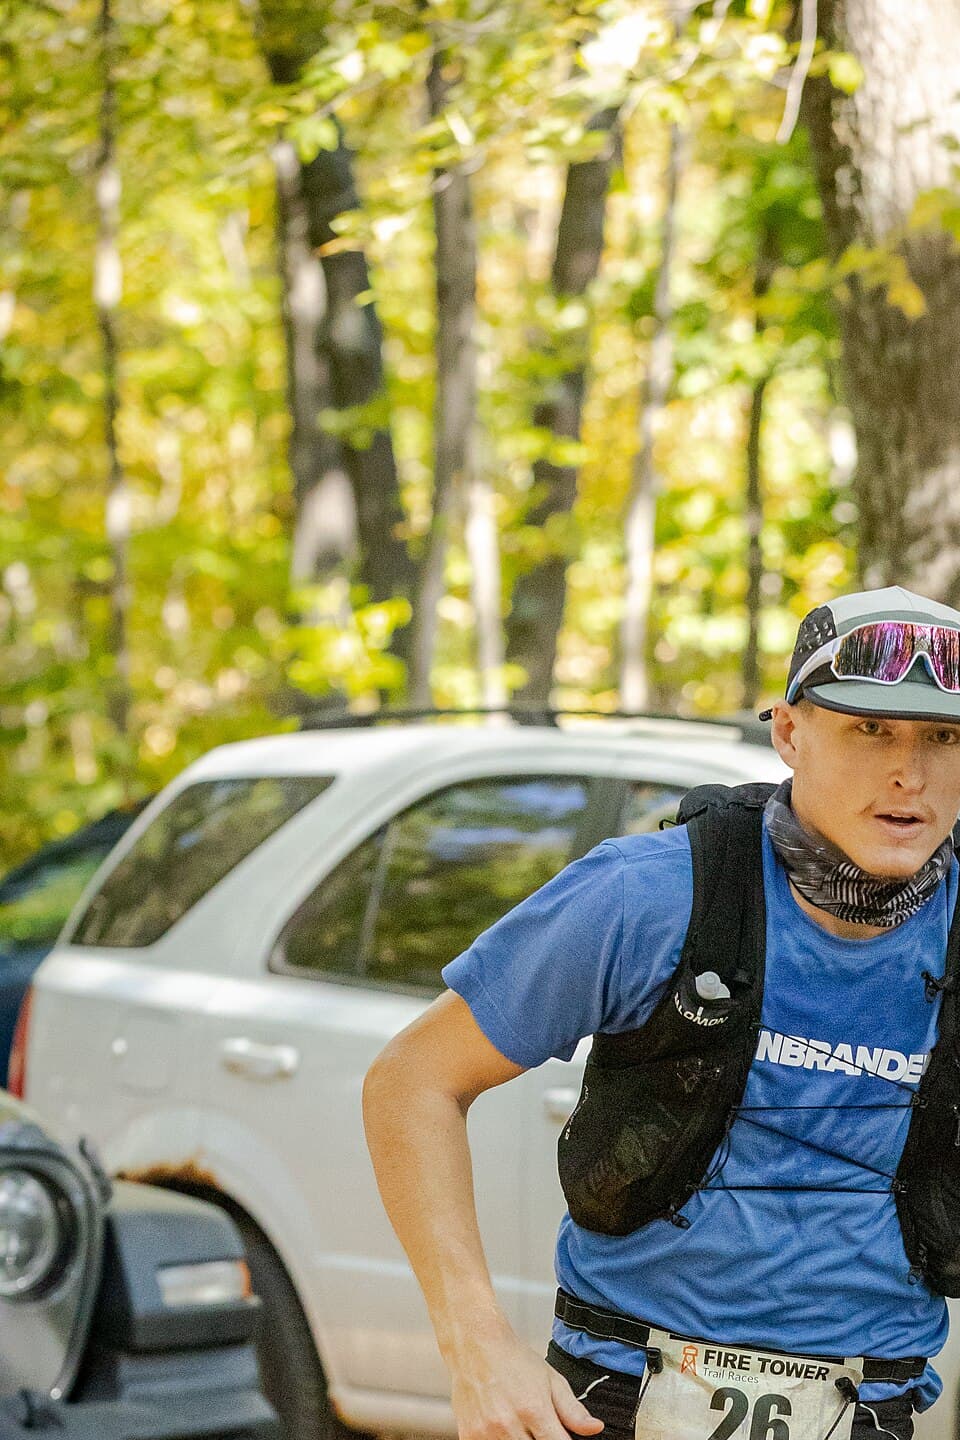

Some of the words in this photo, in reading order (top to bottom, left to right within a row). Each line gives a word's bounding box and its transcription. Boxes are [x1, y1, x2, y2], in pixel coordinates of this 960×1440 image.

[755, 1030, 930, 1084] NBRANDE
[703, 1348, 752, 1371] FIRE
[757, 1357, 830, 1381] TOWER
[703, 1367, 725, 1380] Trail
[727, 1370, 759, 1384] Races
